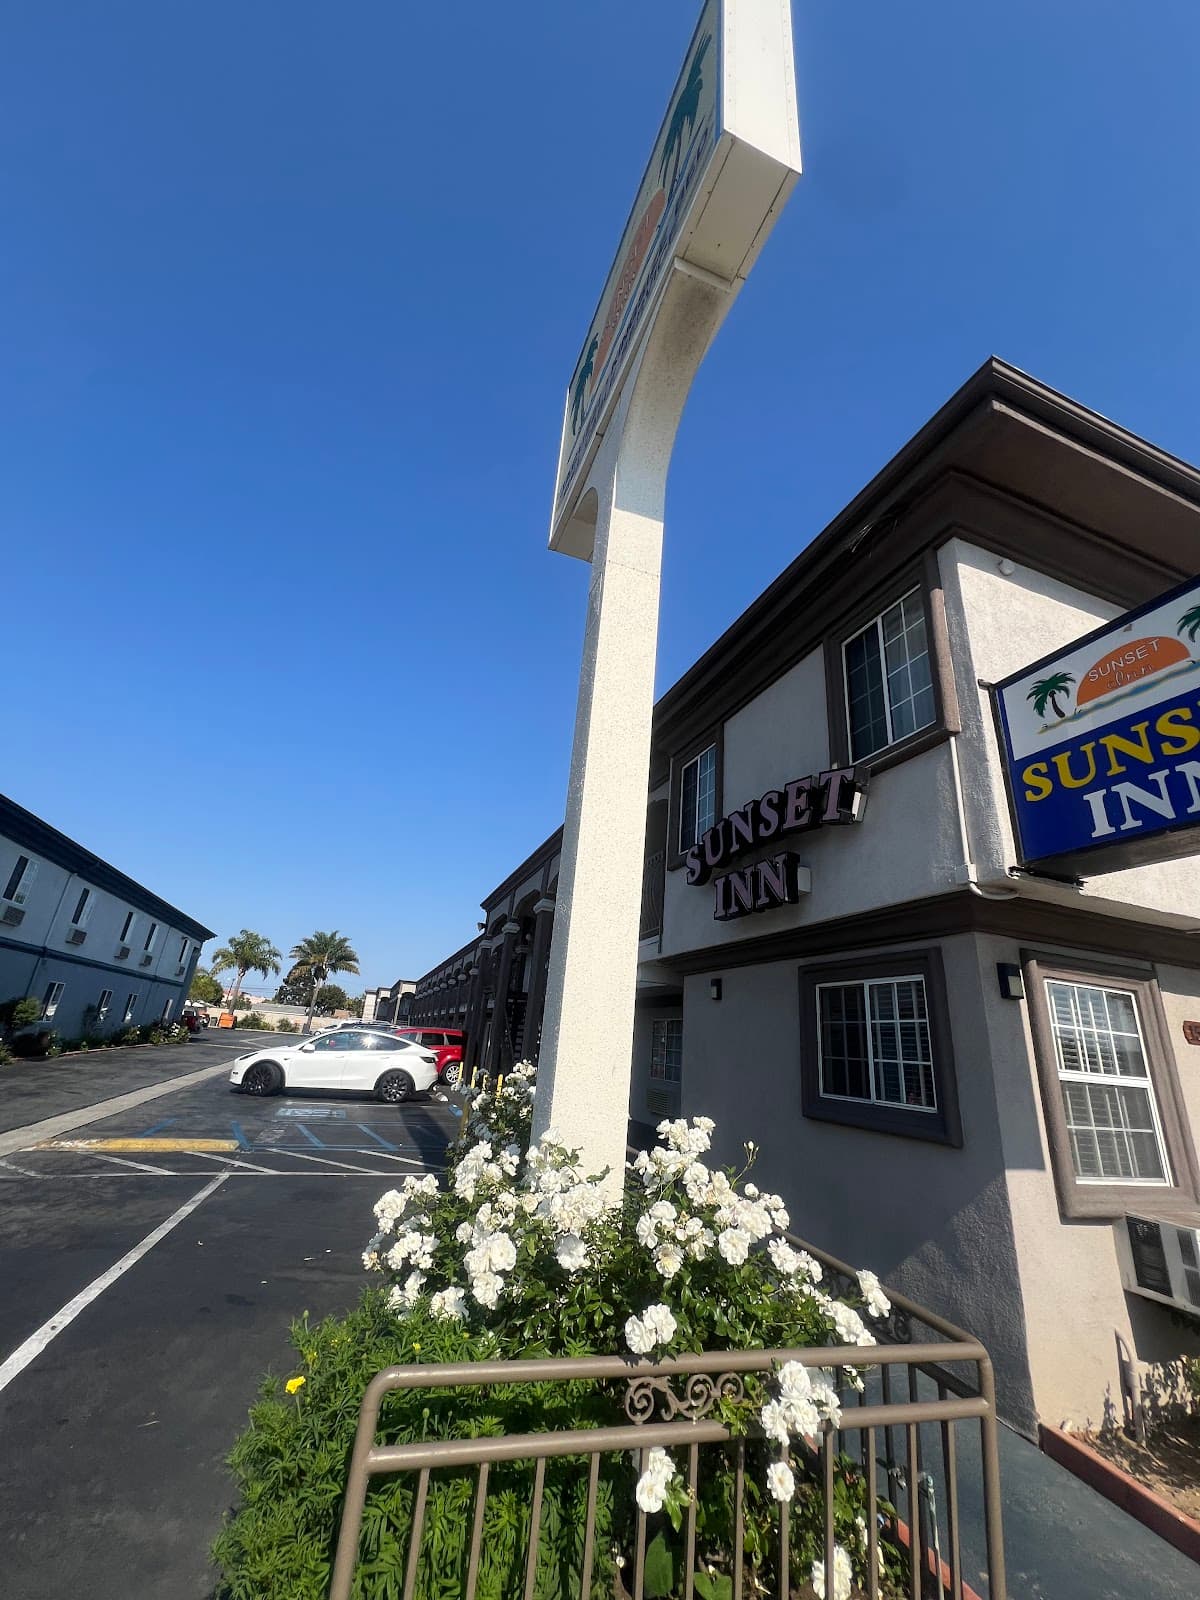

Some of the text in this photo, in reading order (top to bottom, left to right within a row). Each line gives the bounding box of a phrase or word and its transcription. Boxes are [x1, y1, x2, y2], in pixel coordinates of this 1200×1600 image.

[1088, 639, 1160, 682] SUNSET
[1021, 700, 1200, 802] SUNS
[686, 765, 857, 885] SUNSET
[713, 852, 792, 921] INN
